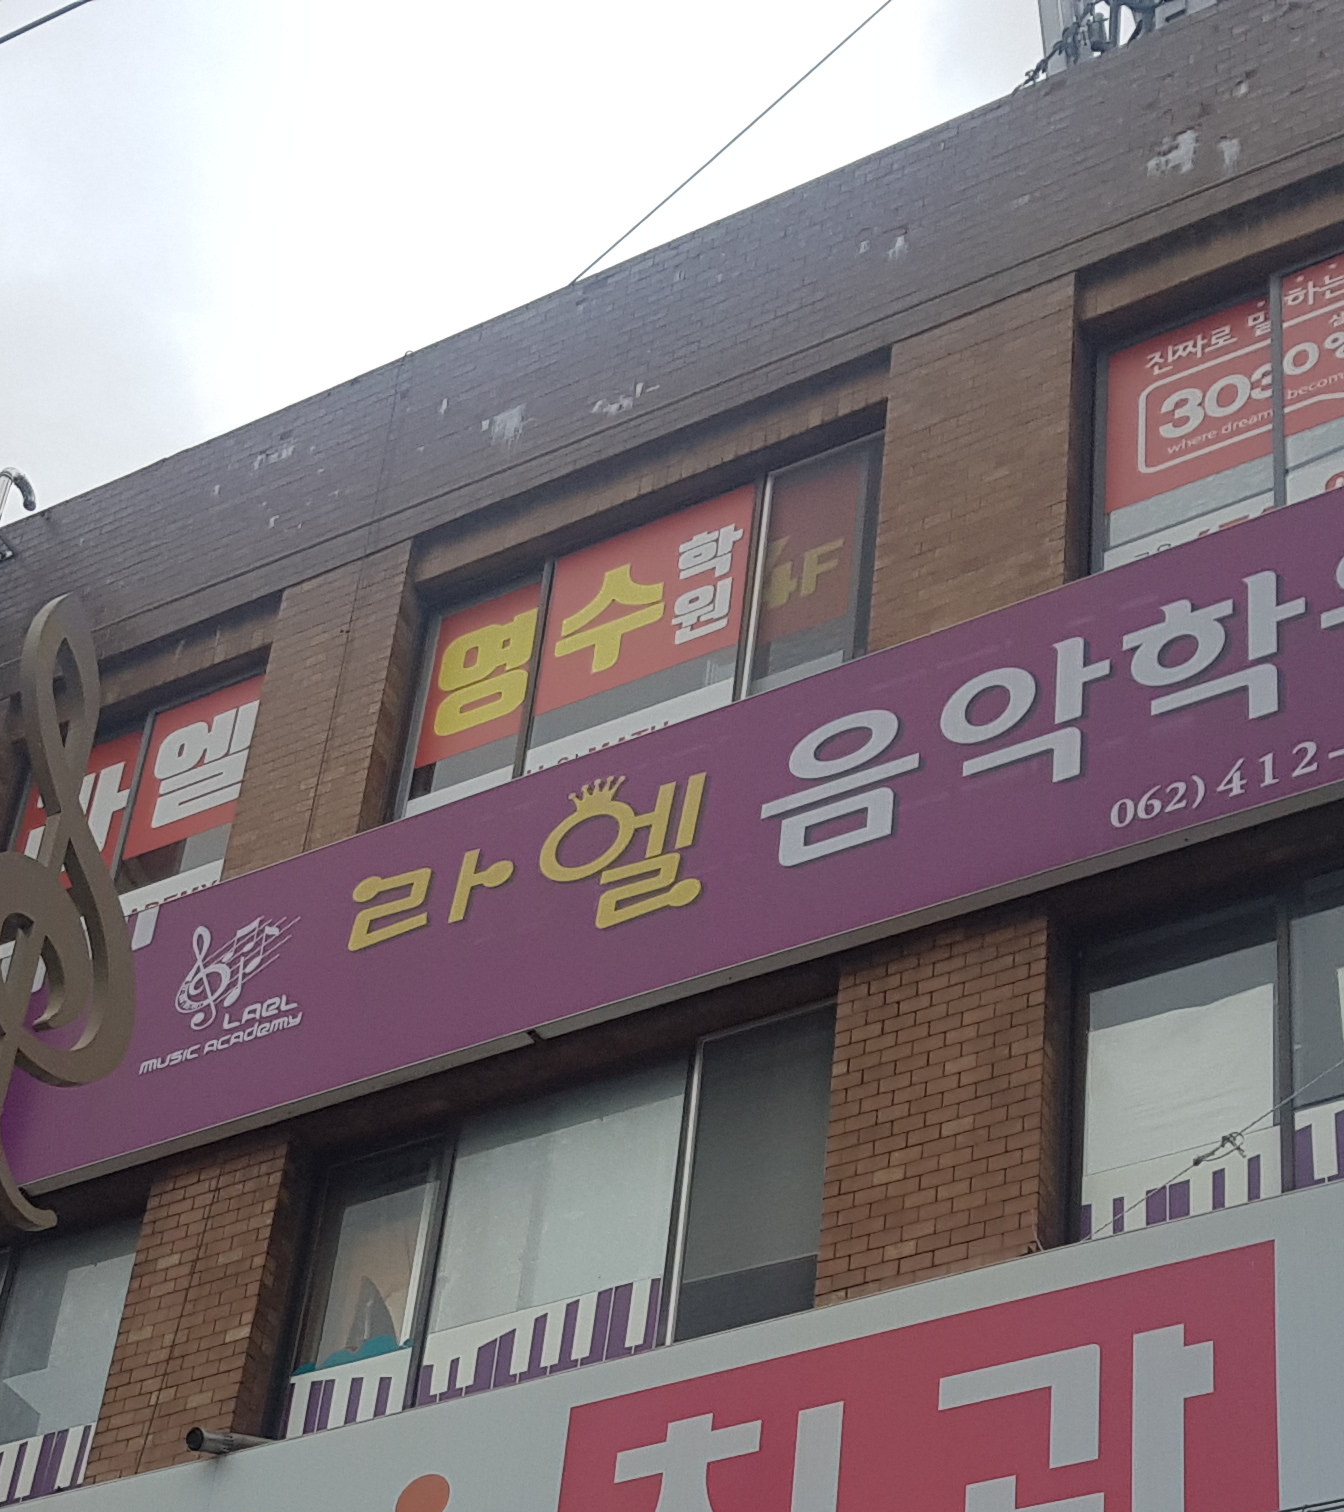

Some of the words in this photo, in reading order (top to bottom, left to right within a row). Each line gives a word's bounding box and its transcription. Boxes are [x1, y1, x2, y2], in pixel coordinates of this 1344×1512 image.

[1145, 325, 1238, 375] 진짜로
[1167, 428, 1217, 454] where
[1222, 408, 1274, 434] dream
[671, 523, 744, 645] 학원
[434, 563, 665, 737] 영수
[347, 772, 708, 953] 라엘
